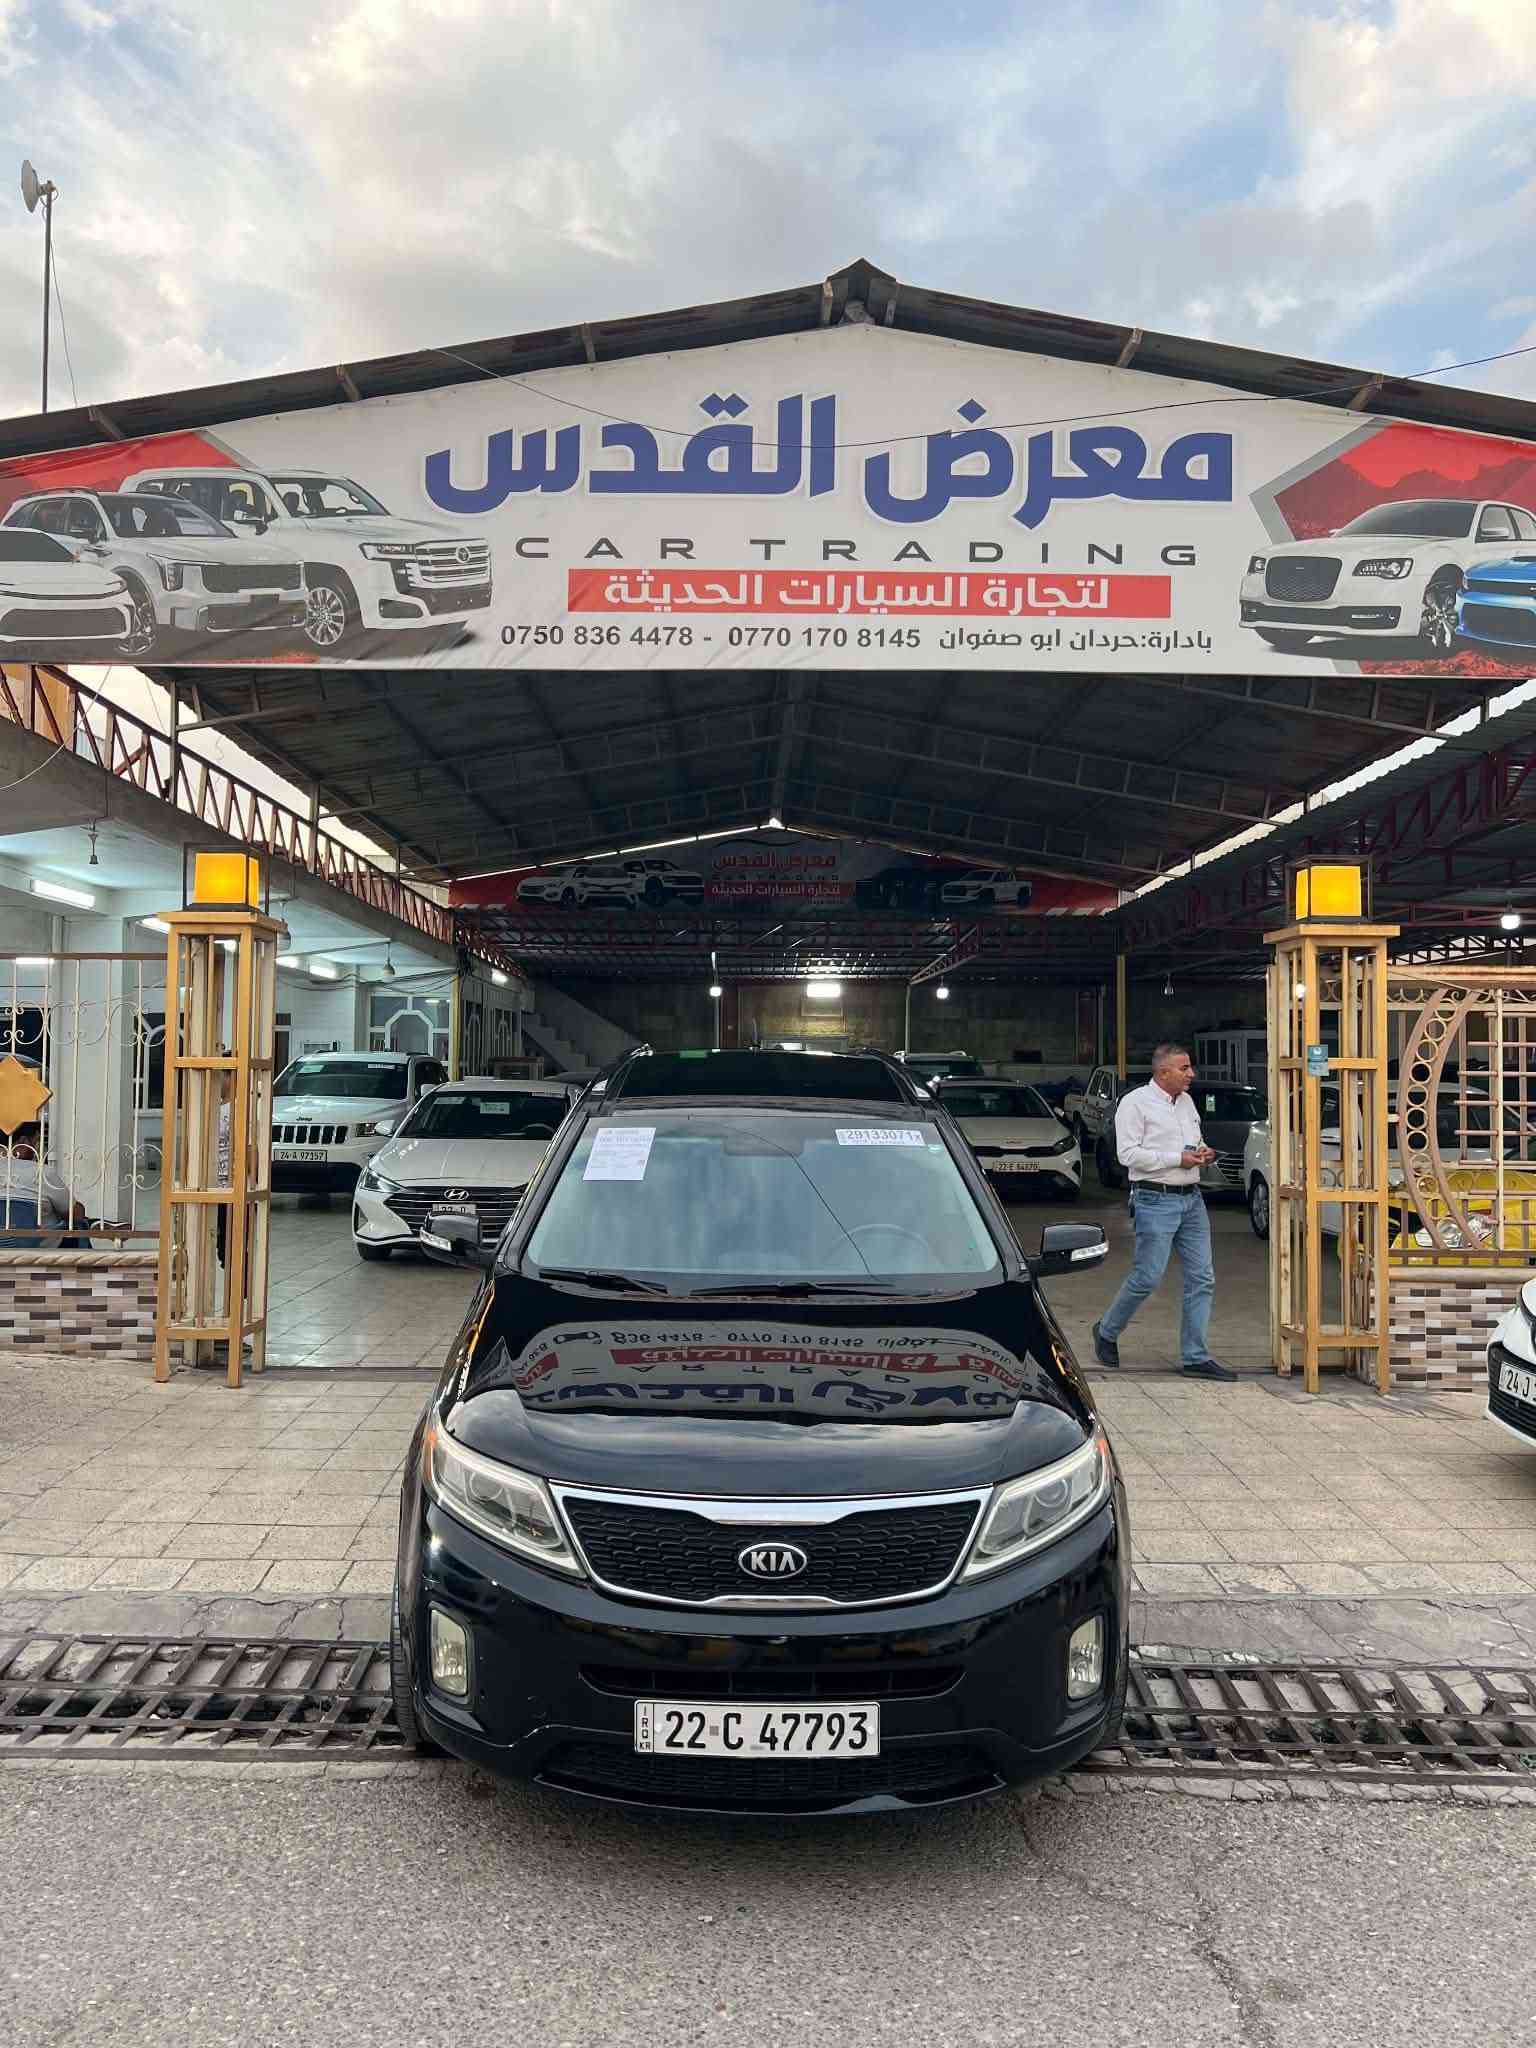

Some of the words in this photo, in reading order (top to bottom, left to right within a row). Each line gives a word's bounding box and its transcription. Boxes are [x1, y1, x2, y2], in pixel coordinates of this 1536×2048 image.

[425, 393, 836, 513] القدس
[865, 398, 1233, 529] معرض
[515, 537, 696, 560] CAR
[750, 539, 1196, 567] TRADING
[604, 568, 763, 612] الحديثة
[779, 573, 968, 615] السيارات
[982, 576, 1109, 615] لتجارة
[500, 625, 564, 645] 0750
[573, 625, 621, 645] 836
[629, 626, 693, 646] 4478
[728, 626, 791, 647] 0770
[801, 627, 848, 647] 170
[856, 628, 921, 648] 8145
[939, 628, 1023, 649] صفوان
[1030, 629, 1061, 651] ابو
[1506, 1369, 1519, 1393] 24
[1523, 1376, 1530, 1397] J
[751, 1551, 796, 1571] KIA
[665, 1711, 706, 1749] 22
[723, 1713, 744, 1750] C
[759, 1712, 868, 1751] 47793
